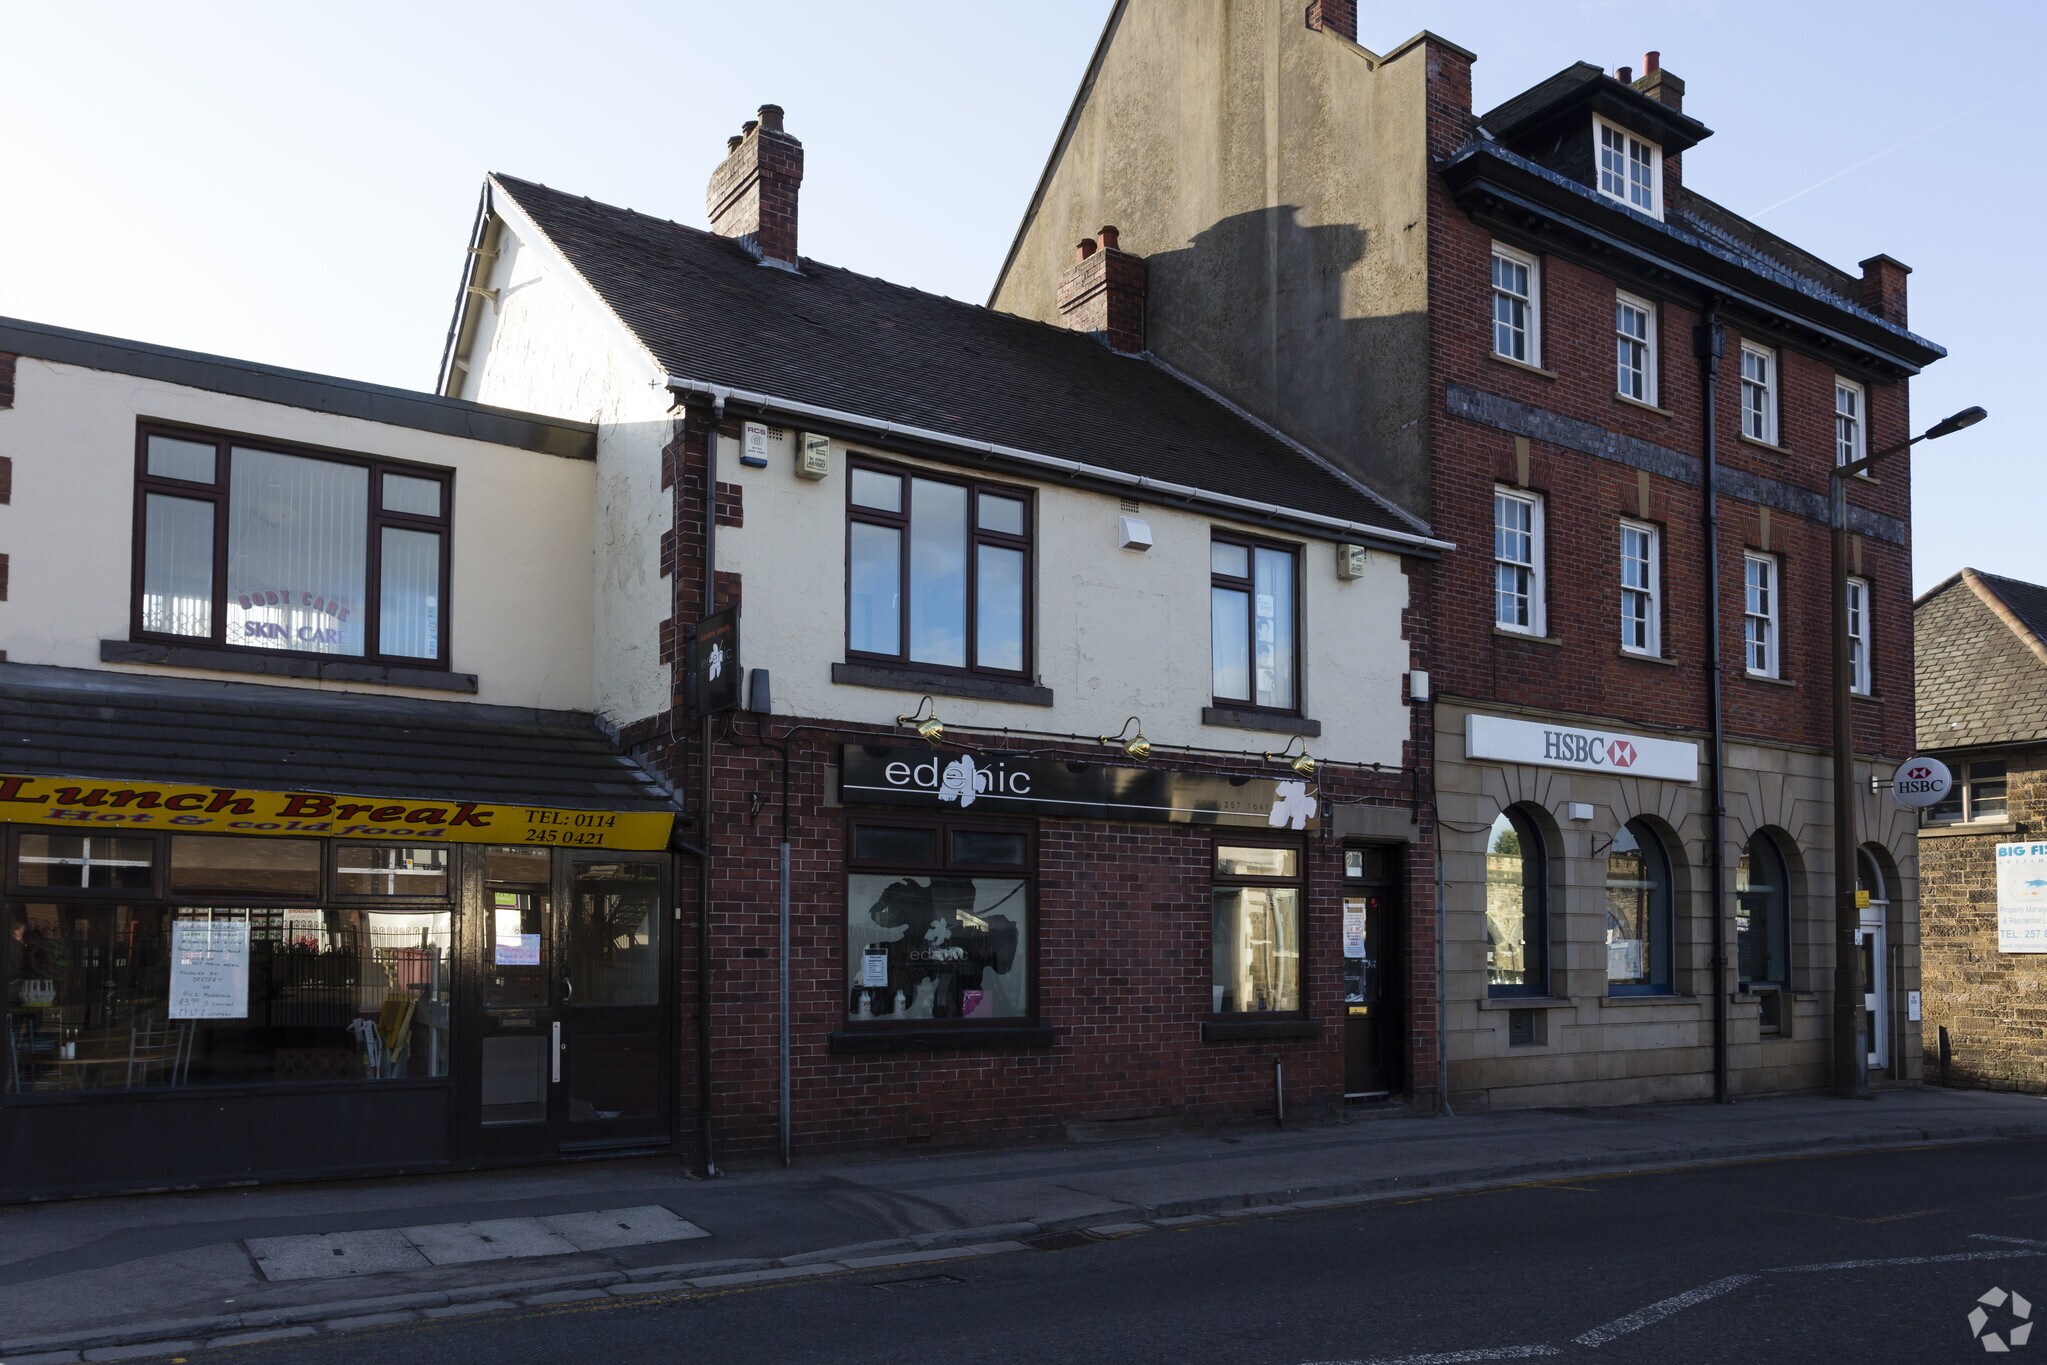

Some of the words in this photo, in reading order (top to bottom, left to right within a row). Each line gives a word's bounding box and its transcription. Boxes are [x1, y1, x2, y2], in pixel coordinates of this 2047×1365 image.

[747, 426, 766, 436] RCS
[239, 590, 290, 611] BODY
[301, 591, 350, 622] CARE
[244, 620, 289, 640] SKIN
[297, 626, 347, 644] CARE
[1543, 730, 1605, 765] HSBC
[885, 756, 1031, 795] edenic
[1899, 779, 1944, 794] HSBC
[0, 777, 255, 815] Lunch
[275, 793, 494, 828] Break
[1224, 801, 1241, 809] 257
[1248, 802, 1269, 811] 1641
[43, 808, 154, 823] Hot
[168, 815, 214, 826] &
[227, 821, 334, 833] cold
[334, 824, 447, 838] food
[525, 810, 569, 826] TEL:
[574, 813, 616, 828] 0114
[525, 828, 558, 842] 245
[562, 832, 605, 845] 0421
[1998, 846, 2025, 857] BIG
[2000, 906, 2025, 916] Property
[2008, 917, 2041, 925] Residential
[2000, 929, 2022, 939] TEL:
[2024, 929, 2041, 939] 257
